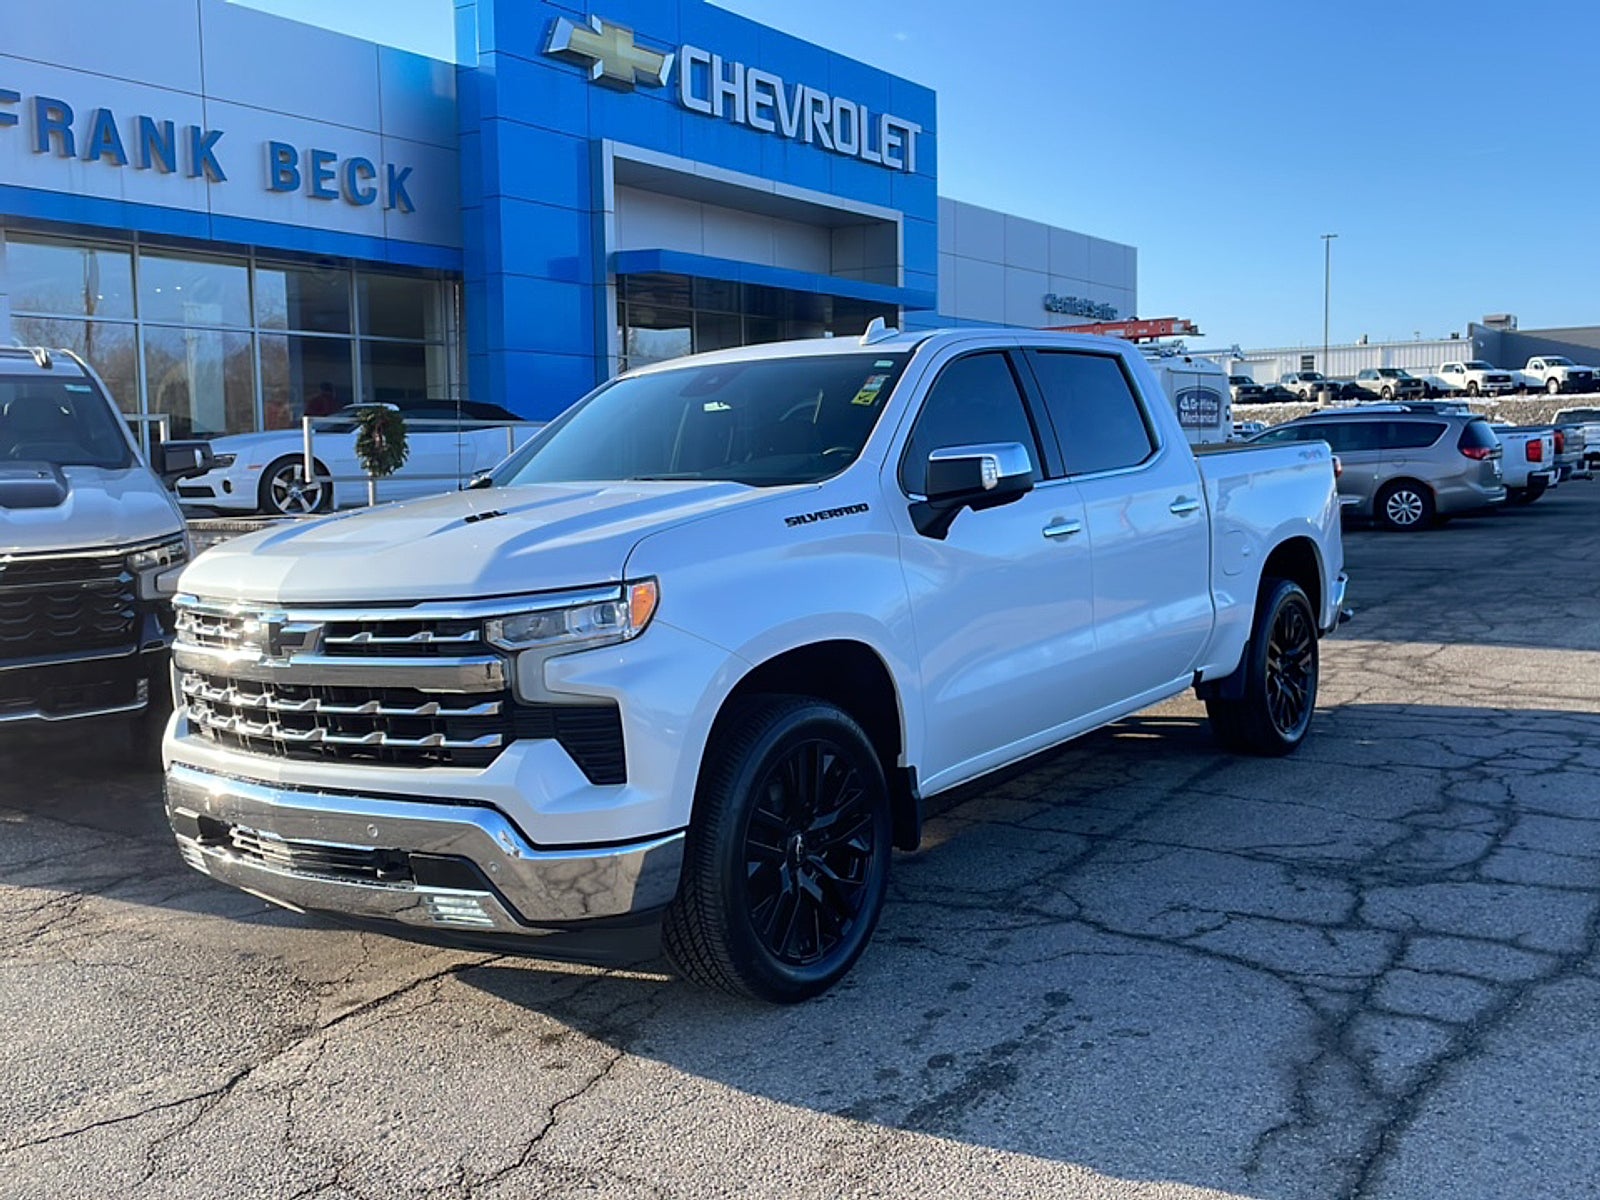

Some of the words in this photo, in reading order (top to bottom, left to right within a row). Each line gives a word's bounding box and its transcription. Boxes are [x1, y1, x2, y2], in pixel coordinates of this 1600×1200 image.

[679, 44, 922, 173] CHEVROLET
[263, 140, 415, 213] BECK
[784, 502, 869, 527] SILVERADO
